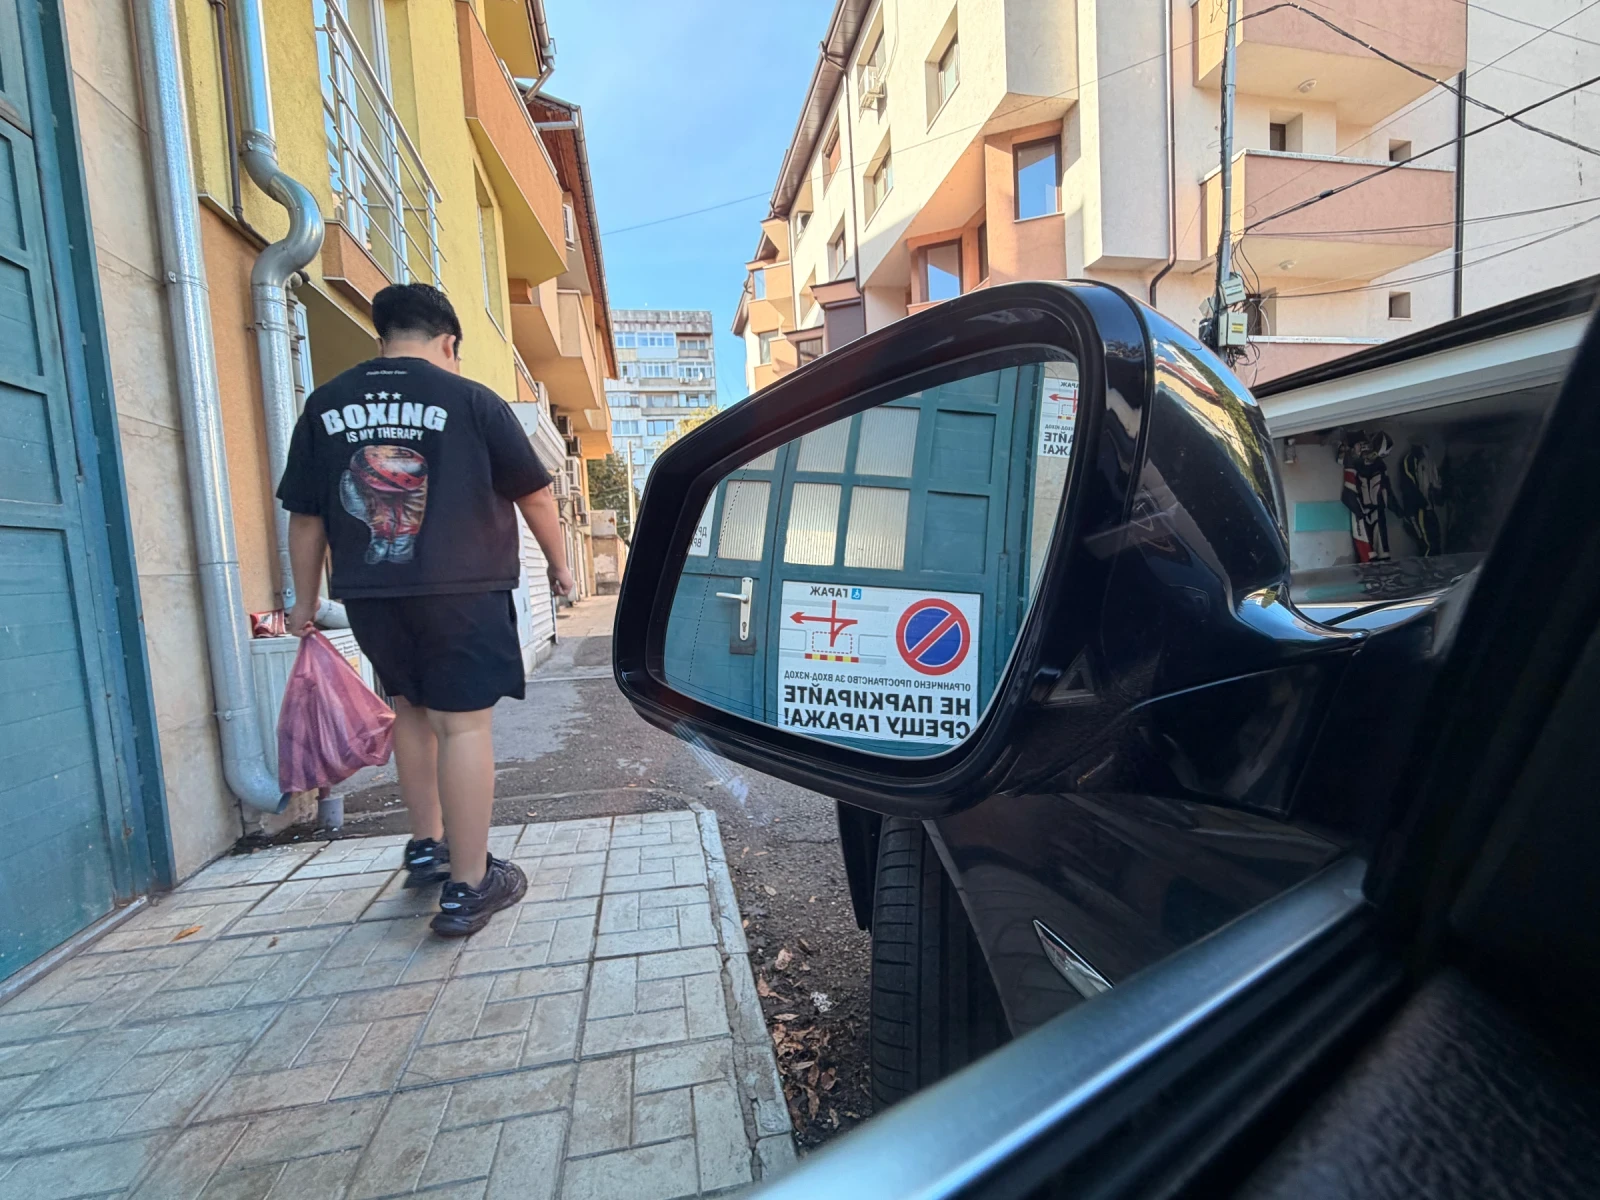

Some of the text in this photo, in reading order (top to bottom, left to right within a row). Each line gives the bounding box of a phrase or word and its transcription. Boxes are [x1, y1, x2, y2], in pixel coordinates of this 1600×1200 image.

[321, 402, 448, 436] BOXING
[346, 427, 424, 443] IS MY THERAPY
